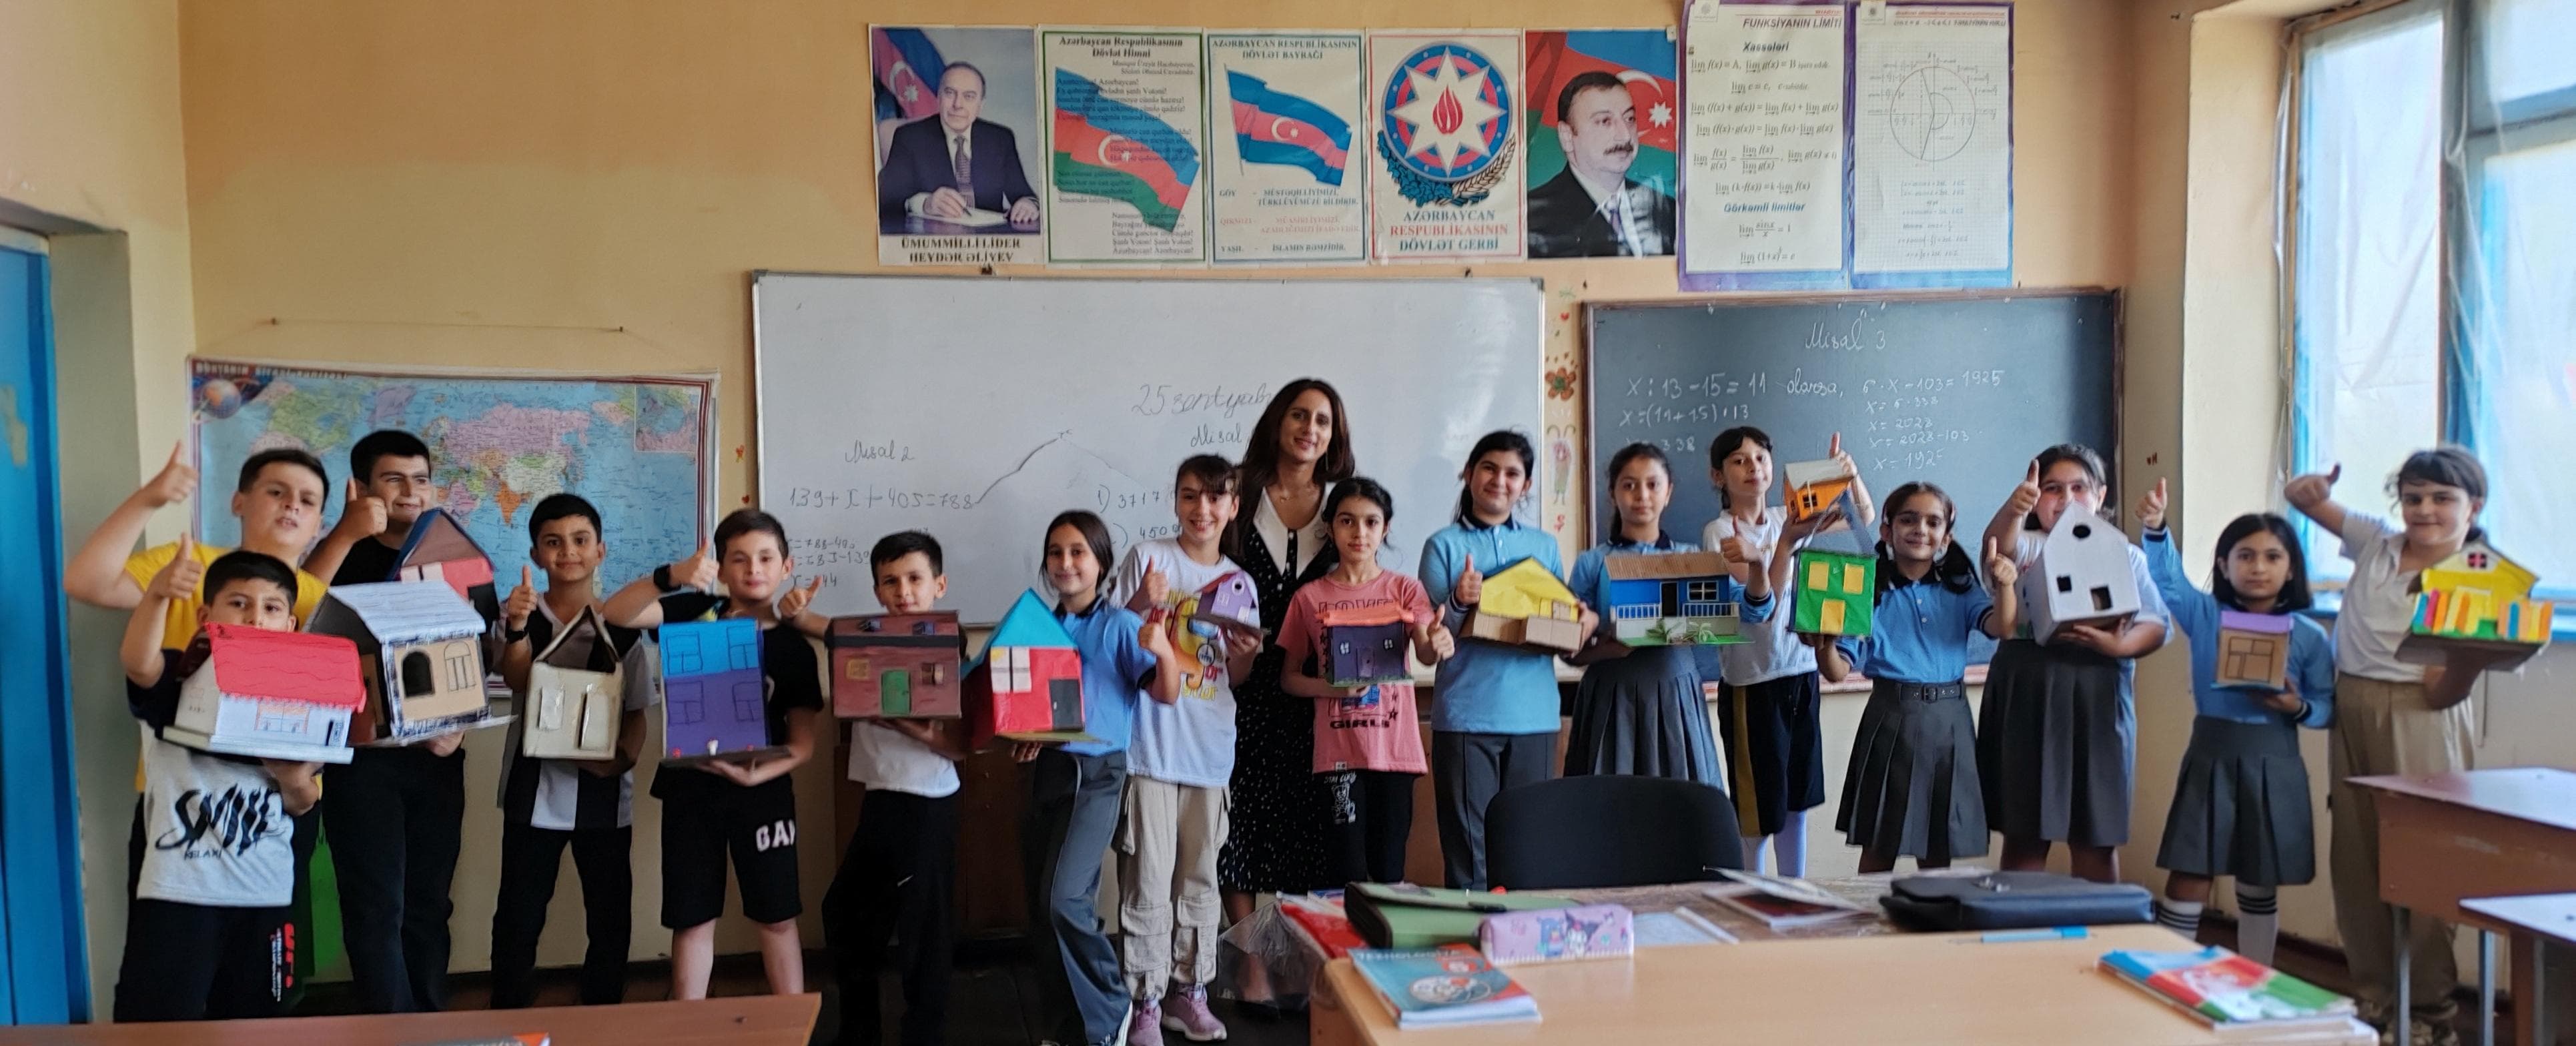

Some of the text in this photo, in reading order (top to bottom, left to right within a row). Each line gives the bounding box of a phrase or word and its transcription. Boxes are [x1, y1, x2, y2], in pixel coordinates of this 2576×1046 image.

[1743, 17, 1842, 29] FUNKSİYANIN LİMİTİ
[1212, 39, 1276, 48] AZƏRBAYCAN
[1242, 49, 1323, 59] DÖVLƏT BAYRAĞI
[1404, 210, 1495, 221] AZƏRBAYCAN
[1390, 223, 1508, 235] RESPUBLİKASININ
[901, 235, 1021, 249] ÜMUMMİLLİ LİDER
[1400, 237, 1499, 251] DÖVLƏT GERBİ
[910, 252, 962, 263] HEYDƏR
[1805, 318, 1885, 350] Misal 3
[1131, 384, 1172, 416] 25
[1191, 423, 1242, 447] Misal
[845, 440, 915, 463] Misal 2
